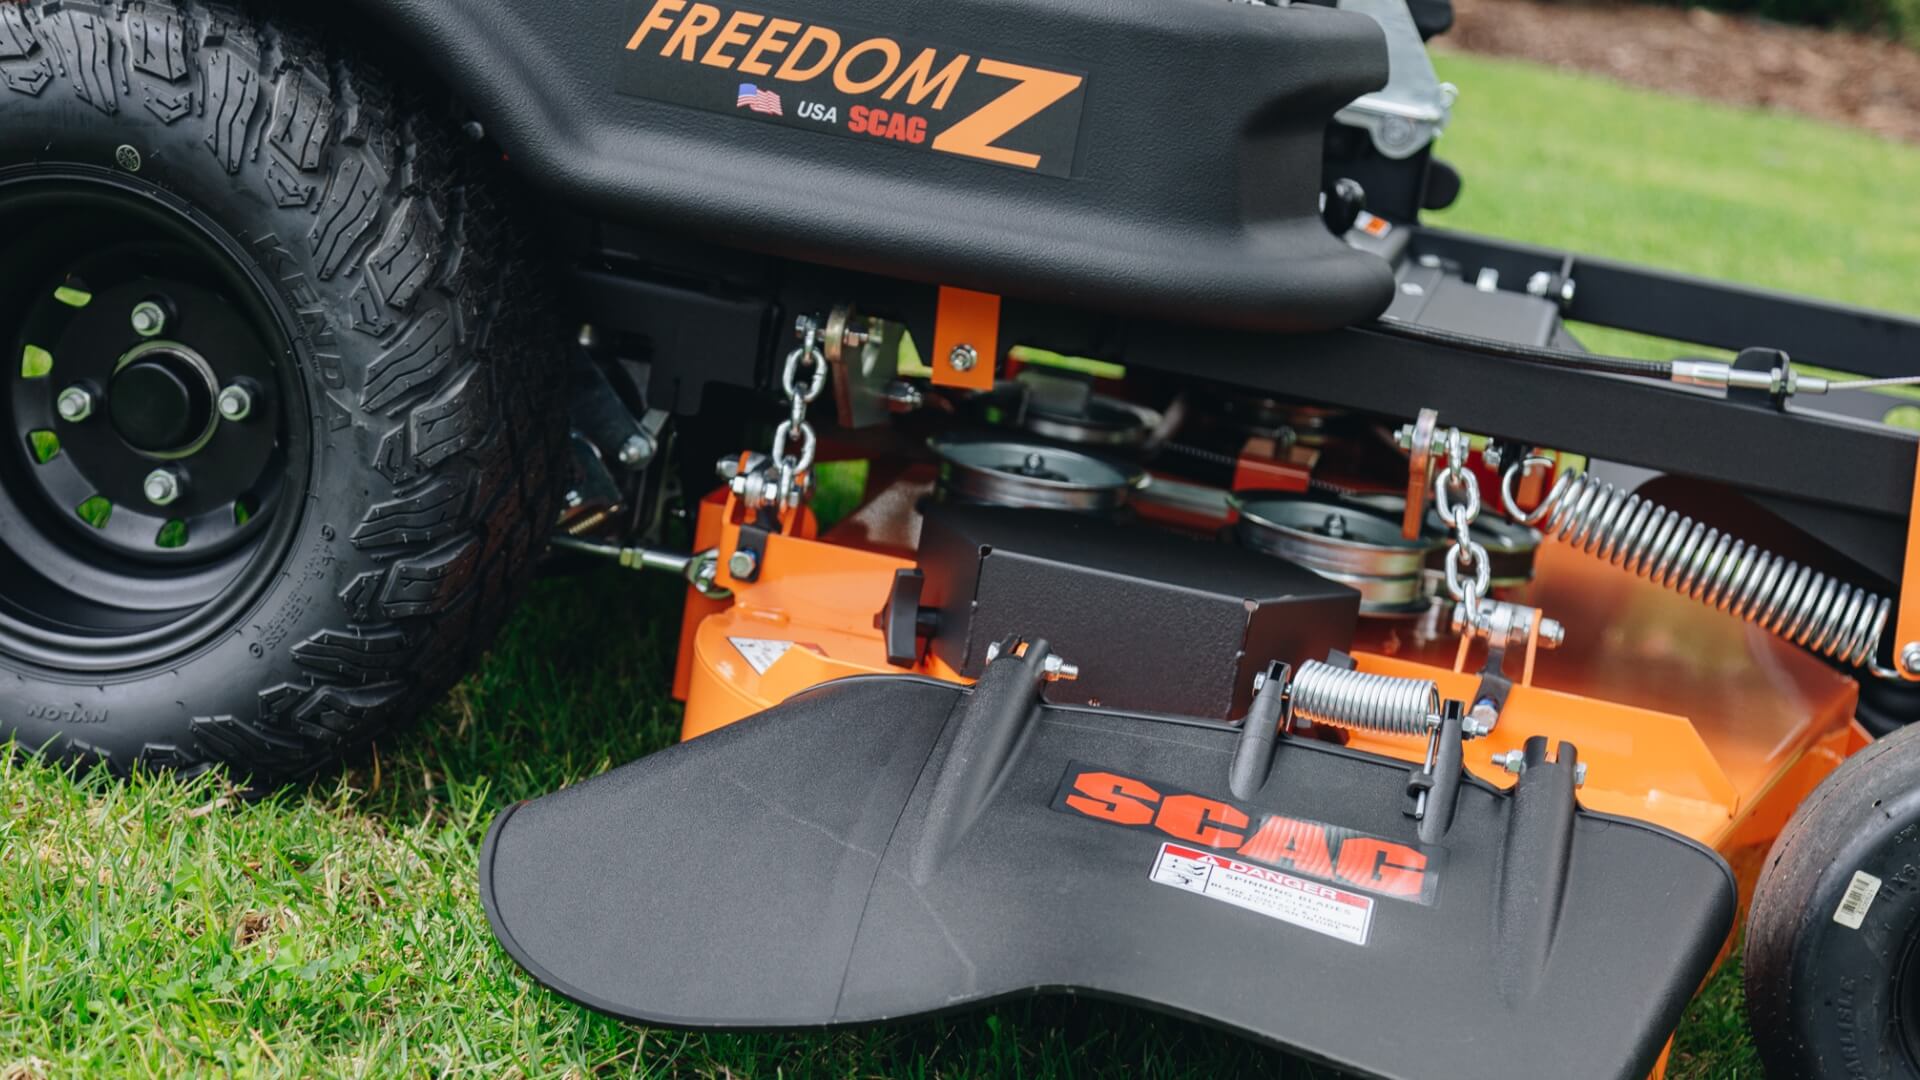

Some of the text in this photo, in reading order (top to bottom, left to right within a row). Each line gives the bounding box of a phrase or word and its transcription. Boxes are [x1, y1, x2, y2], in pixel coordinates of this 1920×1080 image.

[625, 0, 1083, 168] FREEDOM Z
[797, 100, 837, 124] USA
[847, 104, 928, 144] SCAG
[253, 232, 351, 432] KENDA
[27, 703, 109, 723] NYLON
[1066, 771, 1427, 896] SCAG
[1227, 861, 1338, 900] DANGER
